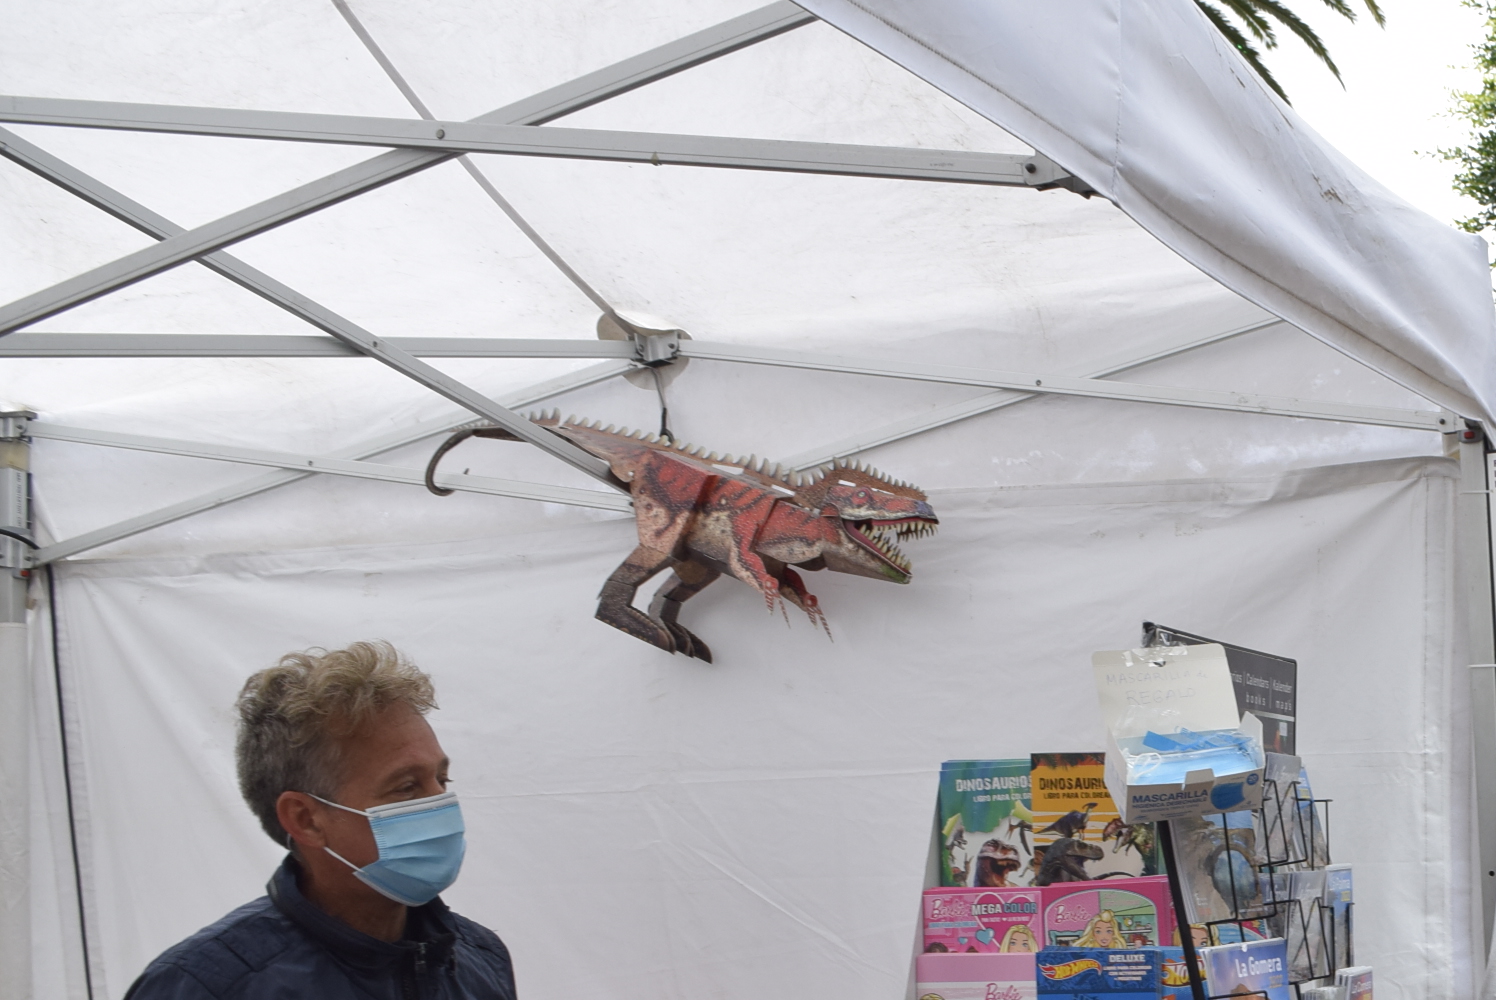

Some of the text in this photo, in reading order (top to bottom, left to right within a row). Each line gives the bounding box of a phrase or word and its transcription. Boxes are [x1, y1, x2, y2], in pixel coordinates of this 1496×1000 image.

[1106, 670, 1191, 686] MASCARILLA
[1132, 789, 1208, 804] MASCARILLA
[971, 902, 1038, 916] MEGA COLOR
[1108, 954, 1146, 963] DELUXE
[1235, 956, 1283, 978] La Gomera
